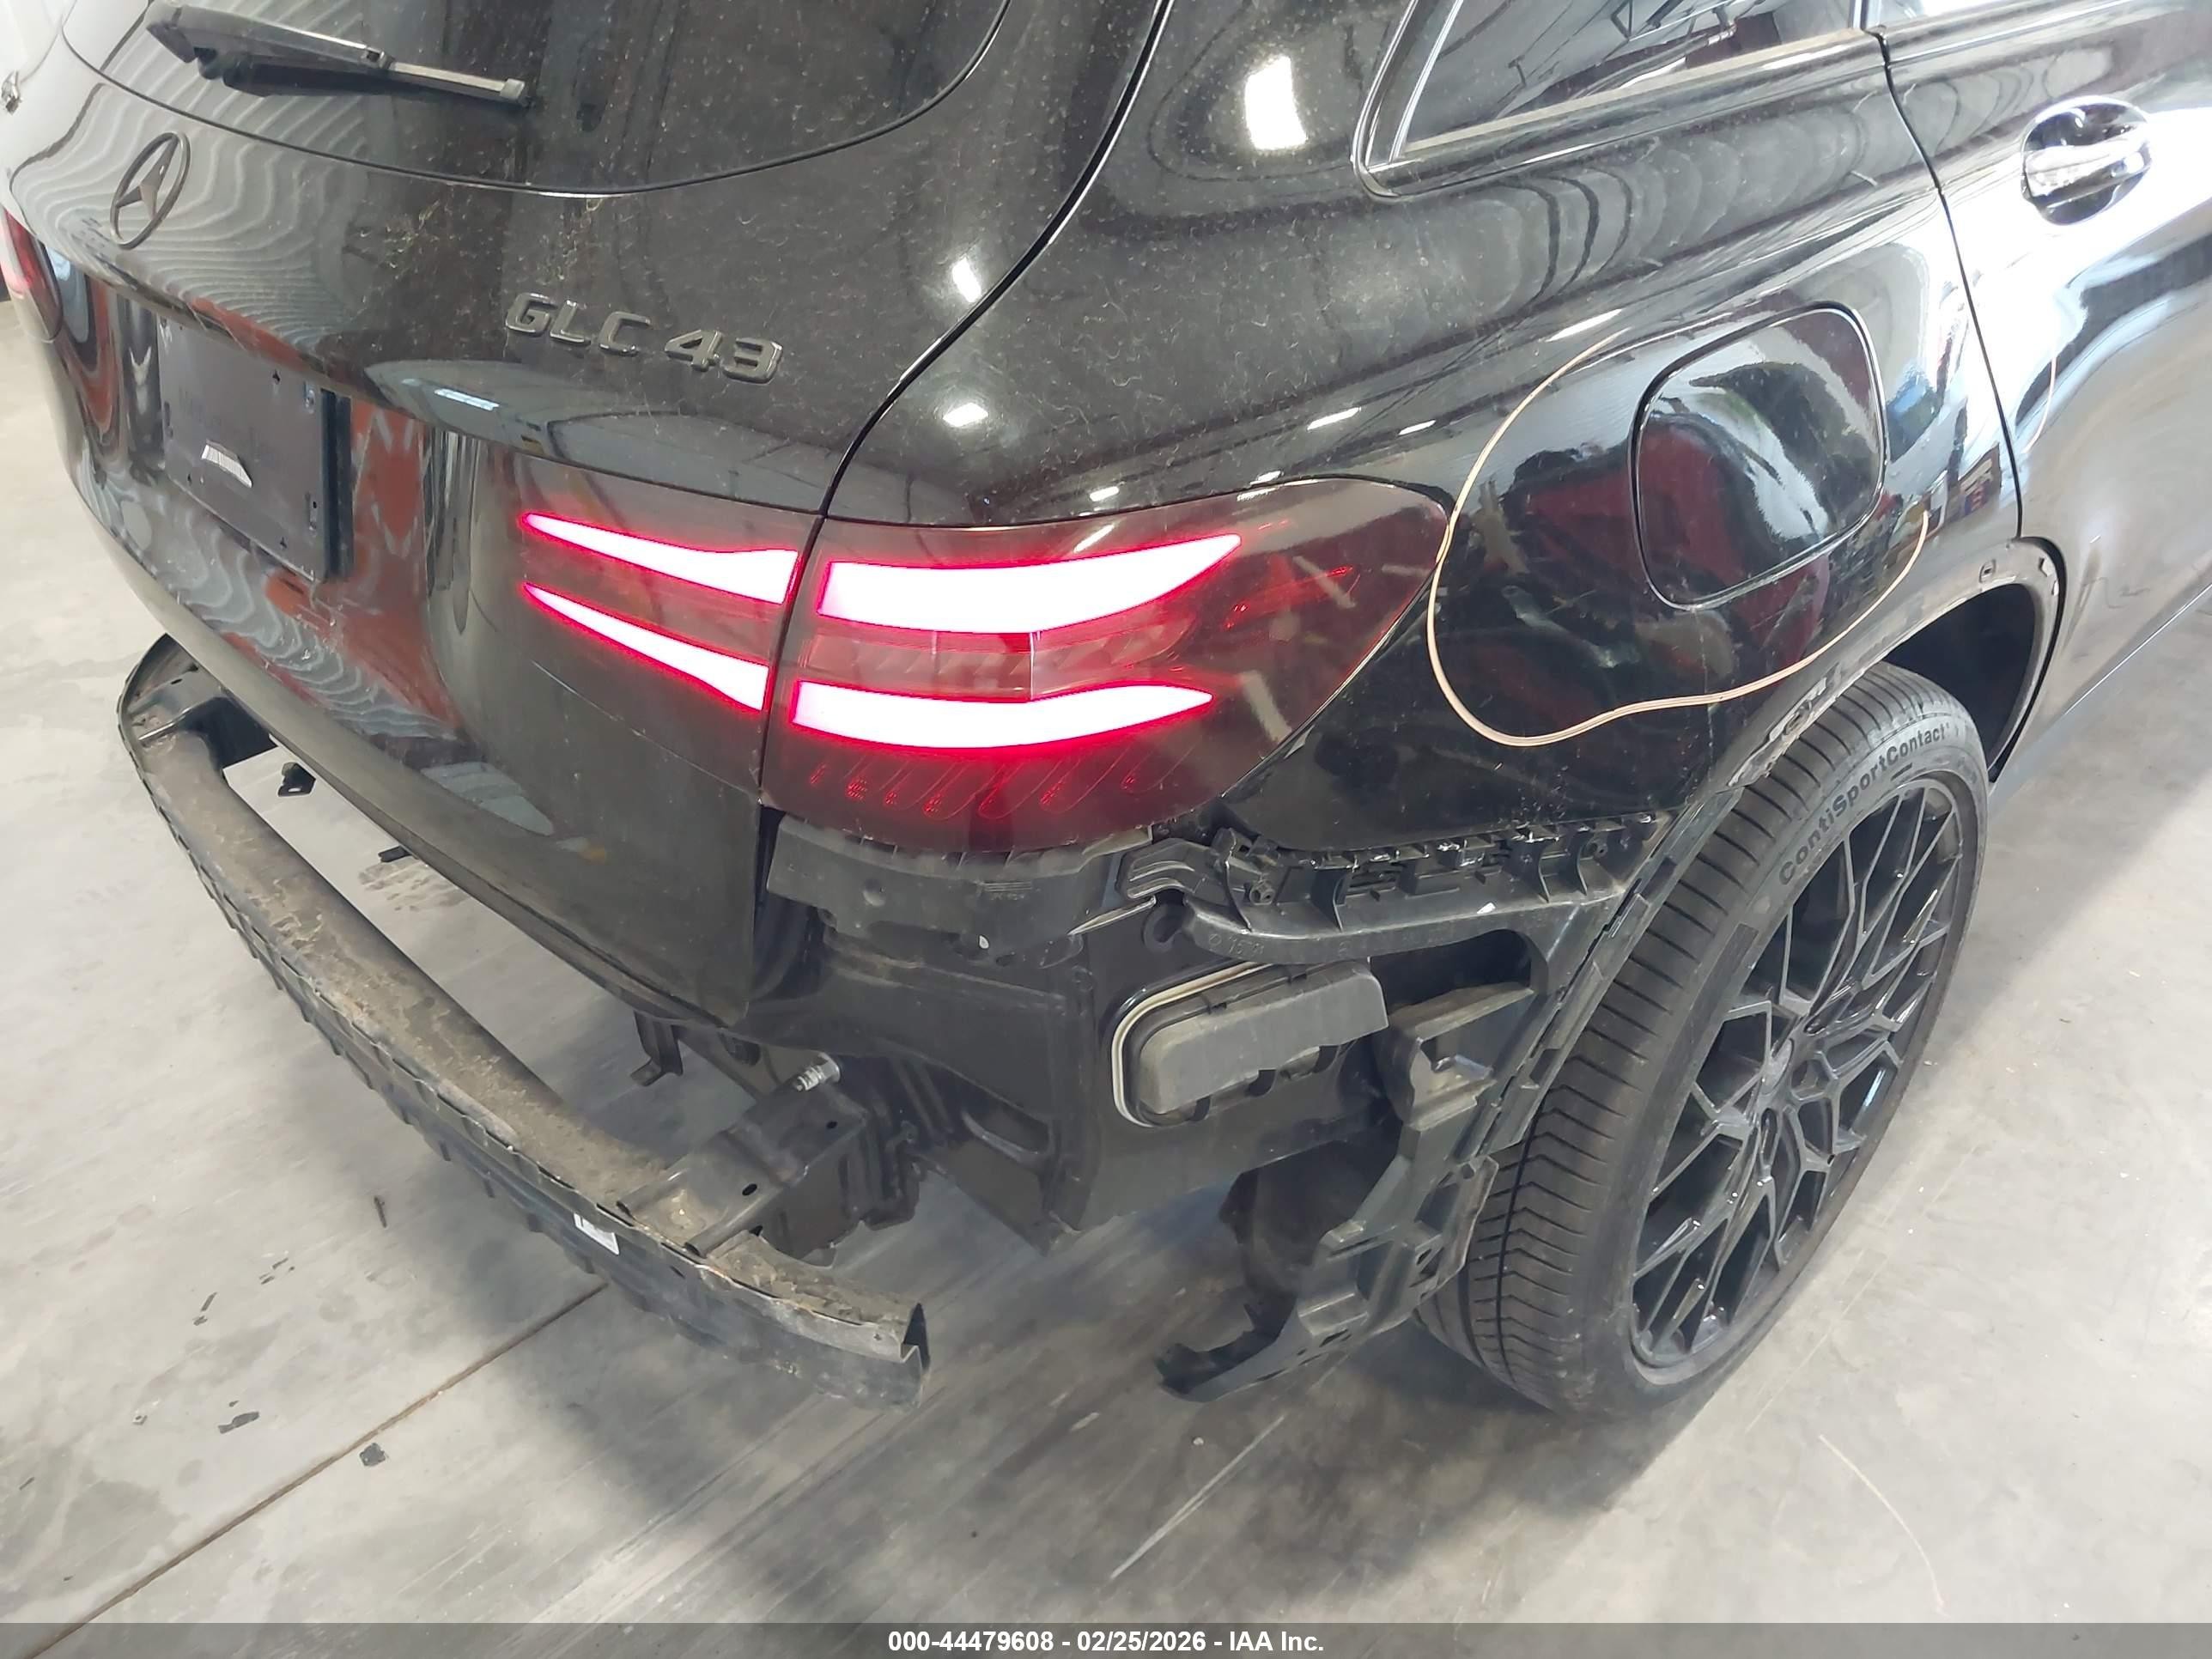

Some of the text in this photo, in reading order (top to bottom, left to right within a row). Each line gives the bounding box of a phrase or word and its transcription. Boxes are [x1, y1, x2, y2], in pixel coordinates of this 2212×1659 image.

[505, 292, 783, 385] GLC 43
[1779, 725, 1946, 885] ContiSportContact
